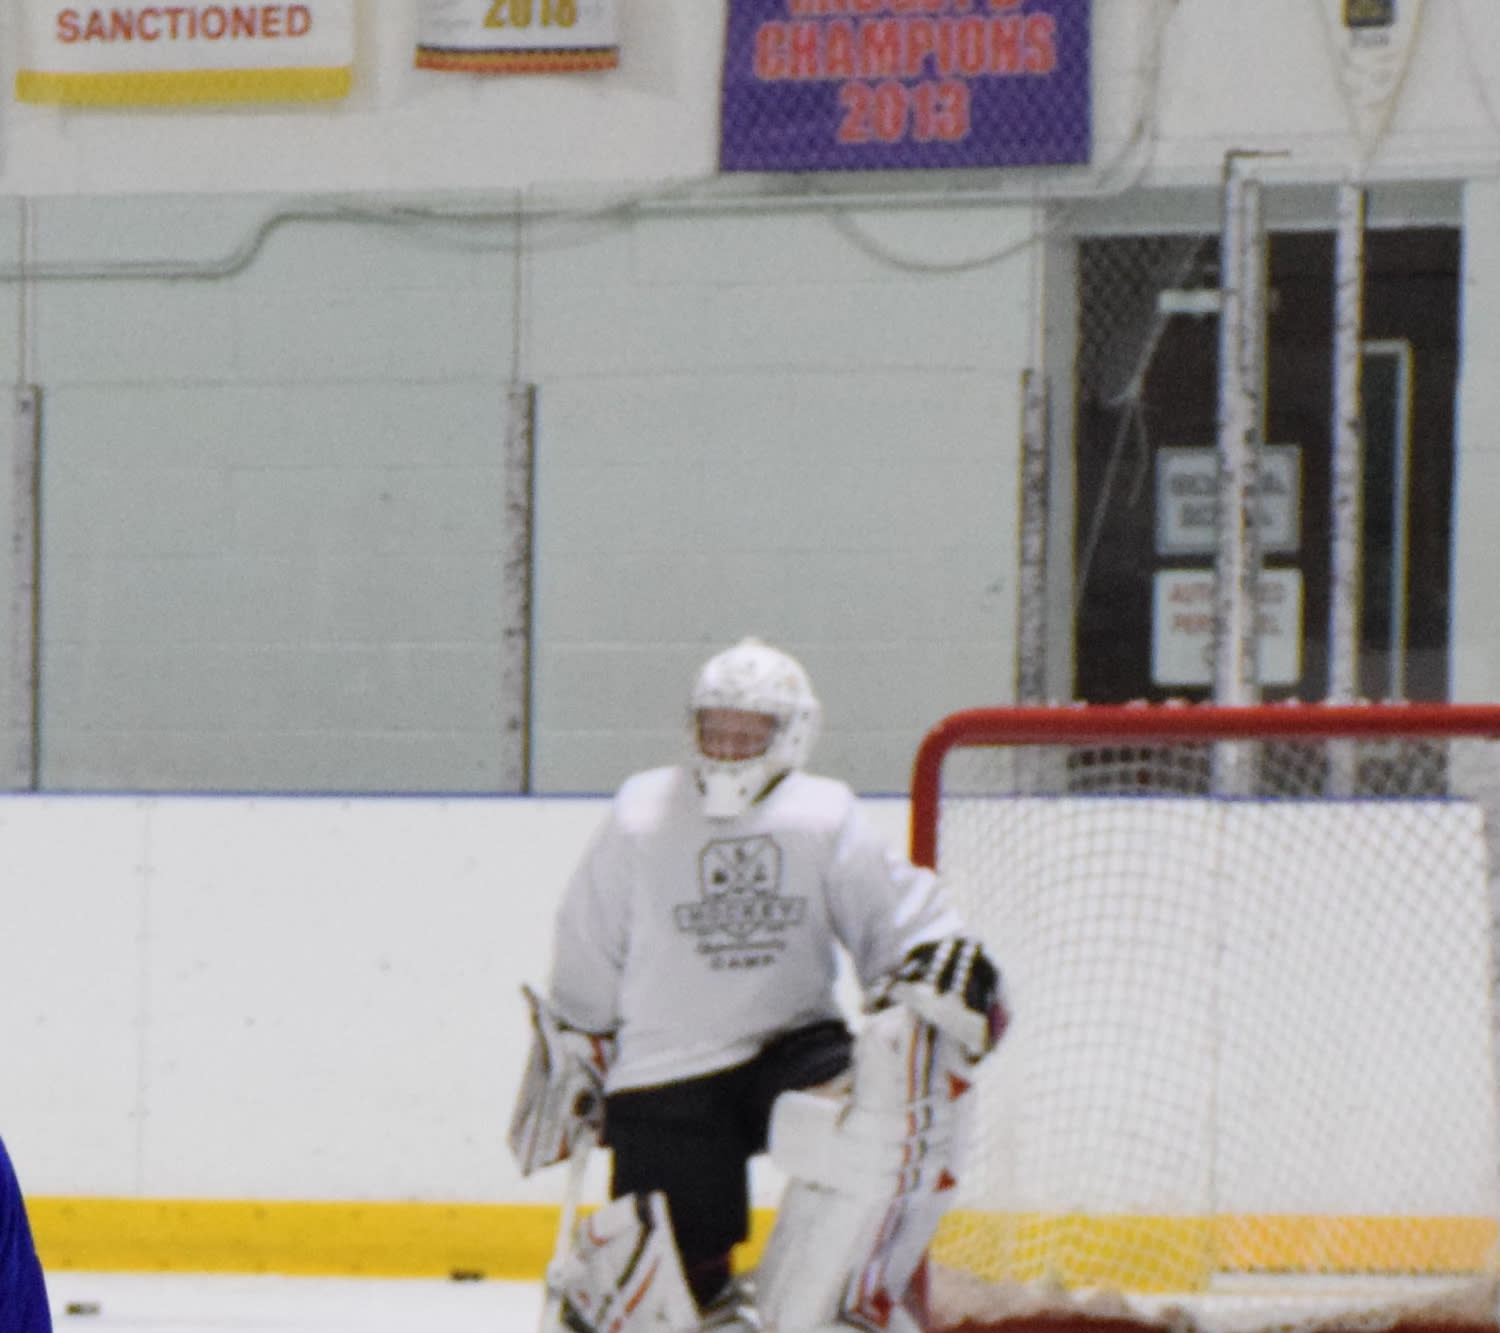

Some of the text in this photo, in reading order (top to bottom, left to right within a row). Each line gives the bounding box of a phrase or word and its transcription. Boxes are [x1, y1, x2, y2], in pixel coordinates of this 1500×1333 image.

[57, 4, 312, 44] SANCTIONED
[754, 14, 1058, 80] CHAMPIONS
[837, 80, 972, 145] 2013
